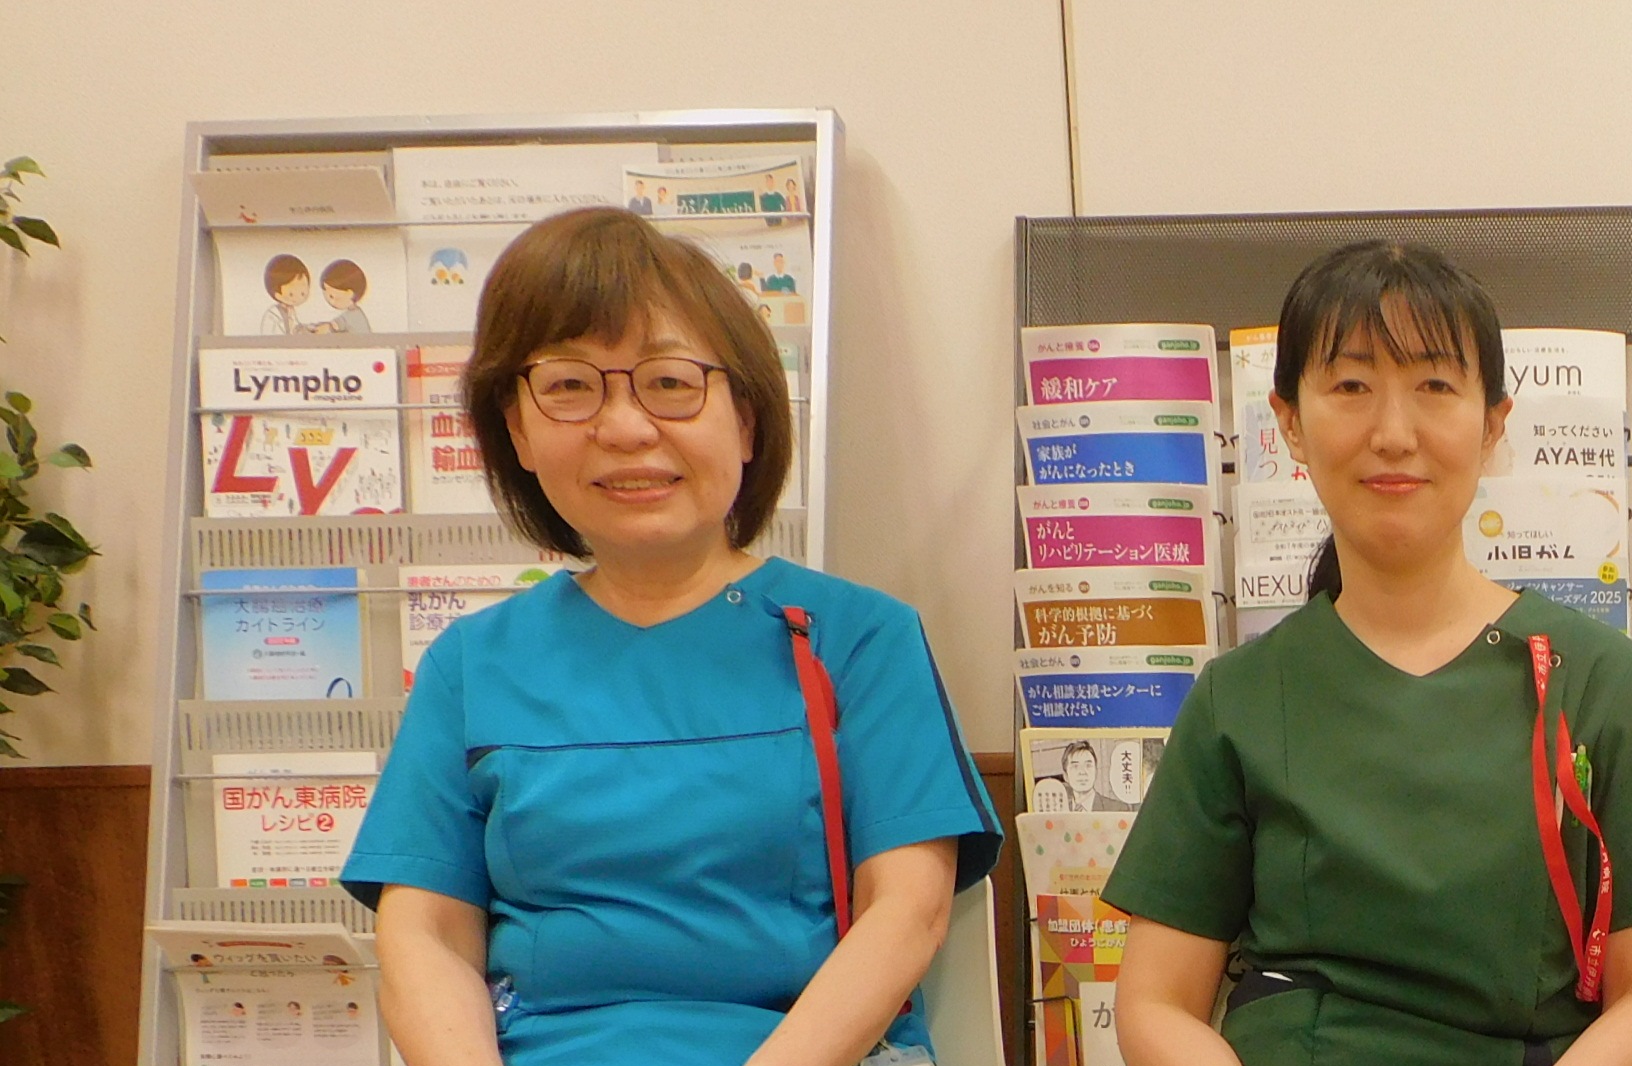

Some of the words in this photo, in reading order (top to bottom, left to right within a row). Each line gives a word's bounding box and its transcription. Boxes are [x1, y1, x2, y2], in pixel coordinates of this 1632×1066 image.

[234, 368, 362, 400] Lympho
[1040, 376, 1118, 401] 緩和ケア
[1509, 365, 1583, 396] yum
[1533, 424, 1614, 437] 知ってください
[1036, 442, 1078, 462] 家族が
[1533, 447, 1616, 467] AYA世代
[1038, 461, 1136, 480] がんになったとき
[1036, 520, 1076, 541] がんと
[1506, 530, 1554, 539] 知ってほしい
[1038, 542, 1190, 563] リハビリテーション医療
[1589, 590, 1622, 605] 2025
[1034, 604, 1155, 623] 科学的根拠に基づく
[1037, 623, 1117, 646] がん予防
[1027, 683, 1162, 701] がん相談支援センターに
[1030, 702, 1102, 718] ご相談ください
[222, 784, 368, 810] 国がん東病院
